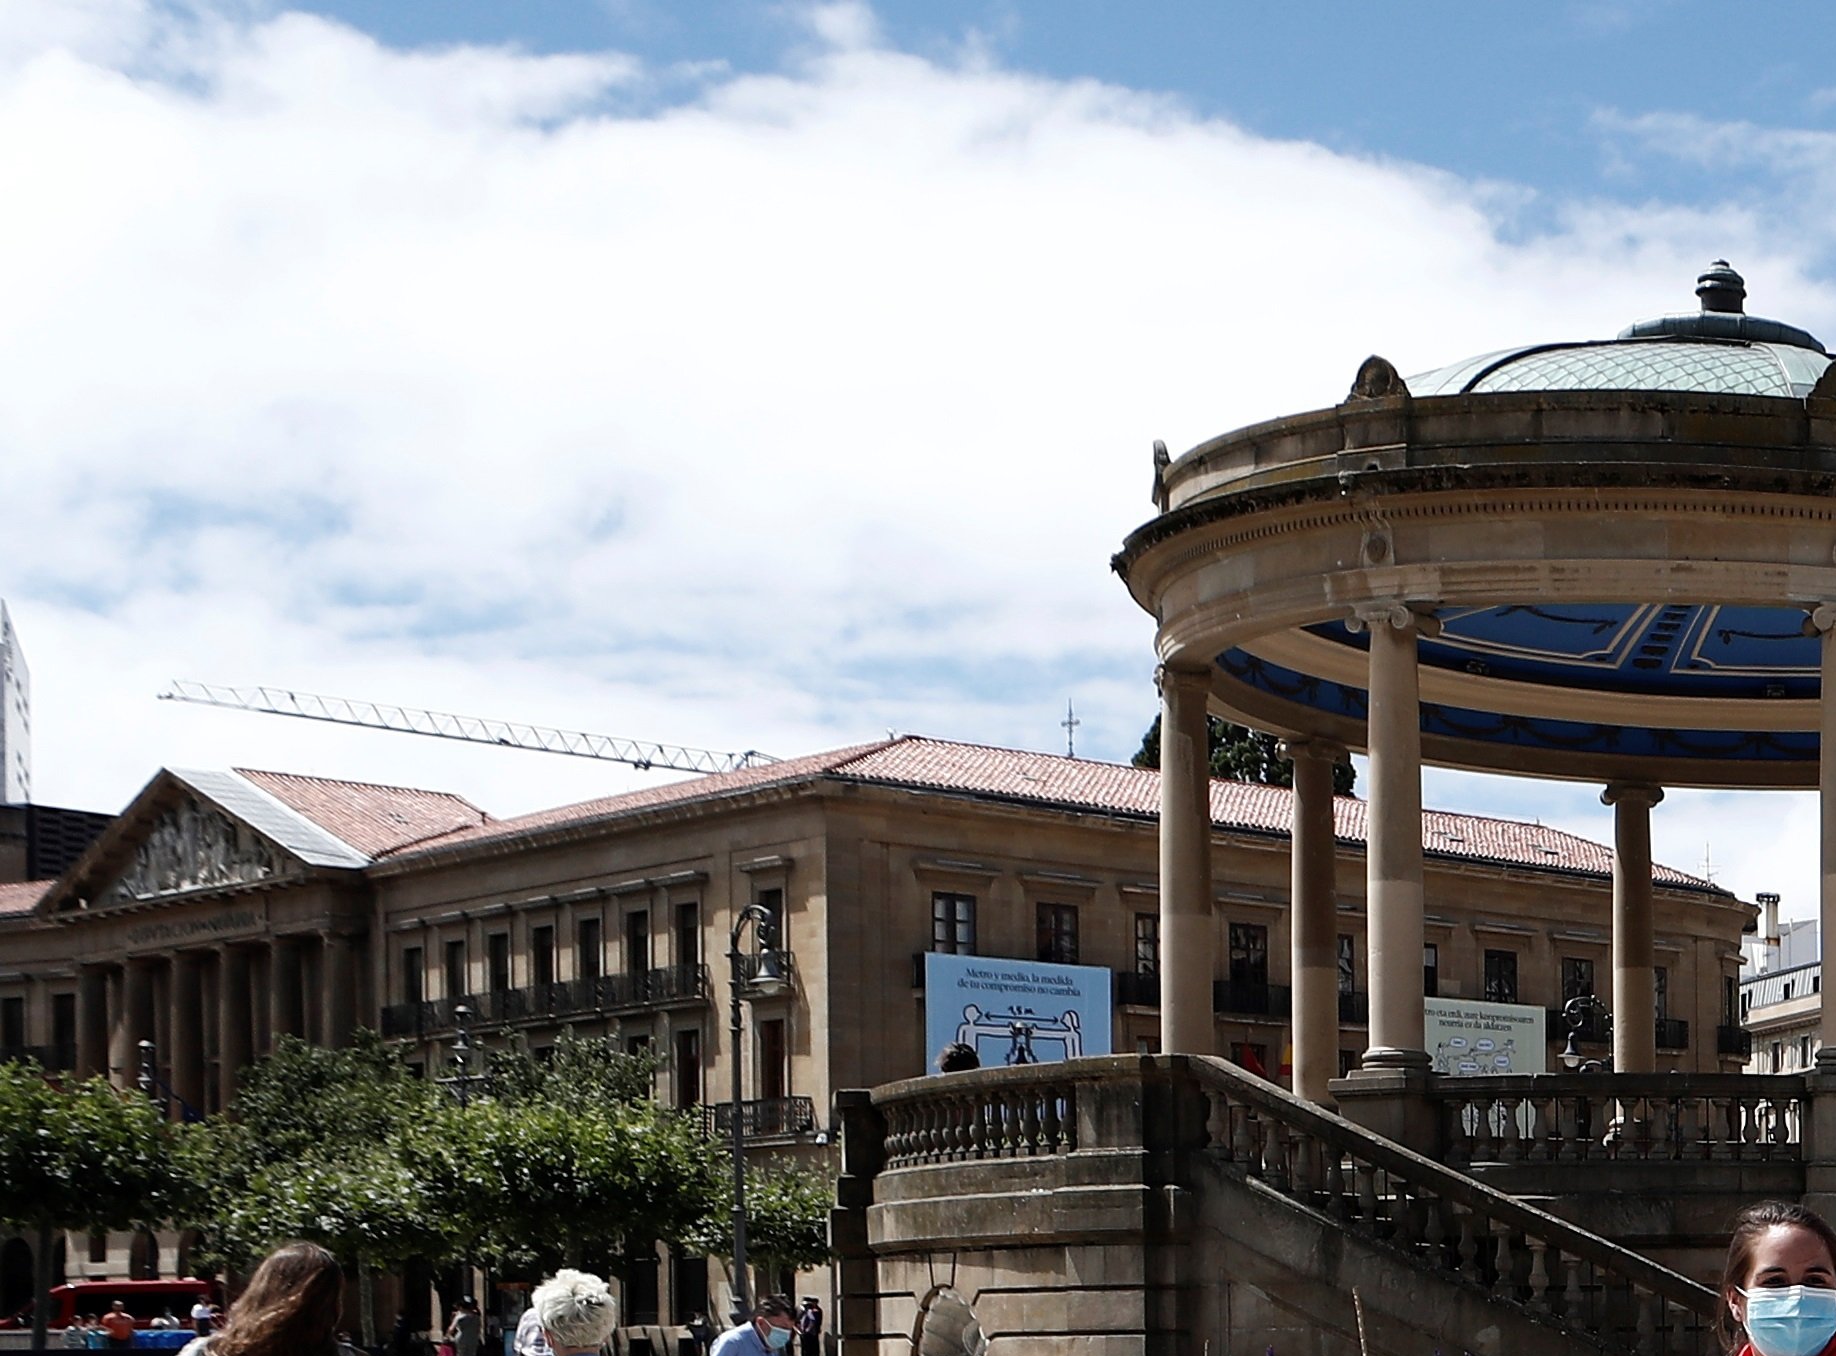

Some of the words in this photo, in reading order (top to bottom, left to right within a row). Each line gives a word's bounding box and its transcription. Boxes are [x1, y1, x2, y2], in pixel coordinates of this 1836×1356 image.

[966, 968, 993, 978] Metro
[1031, 973, 1039, 982] la
[1040, 975, 1073, 985] medida
[980, 982, 1036, 993] compromiso
[1049, 986, 1081, 997] cambia
